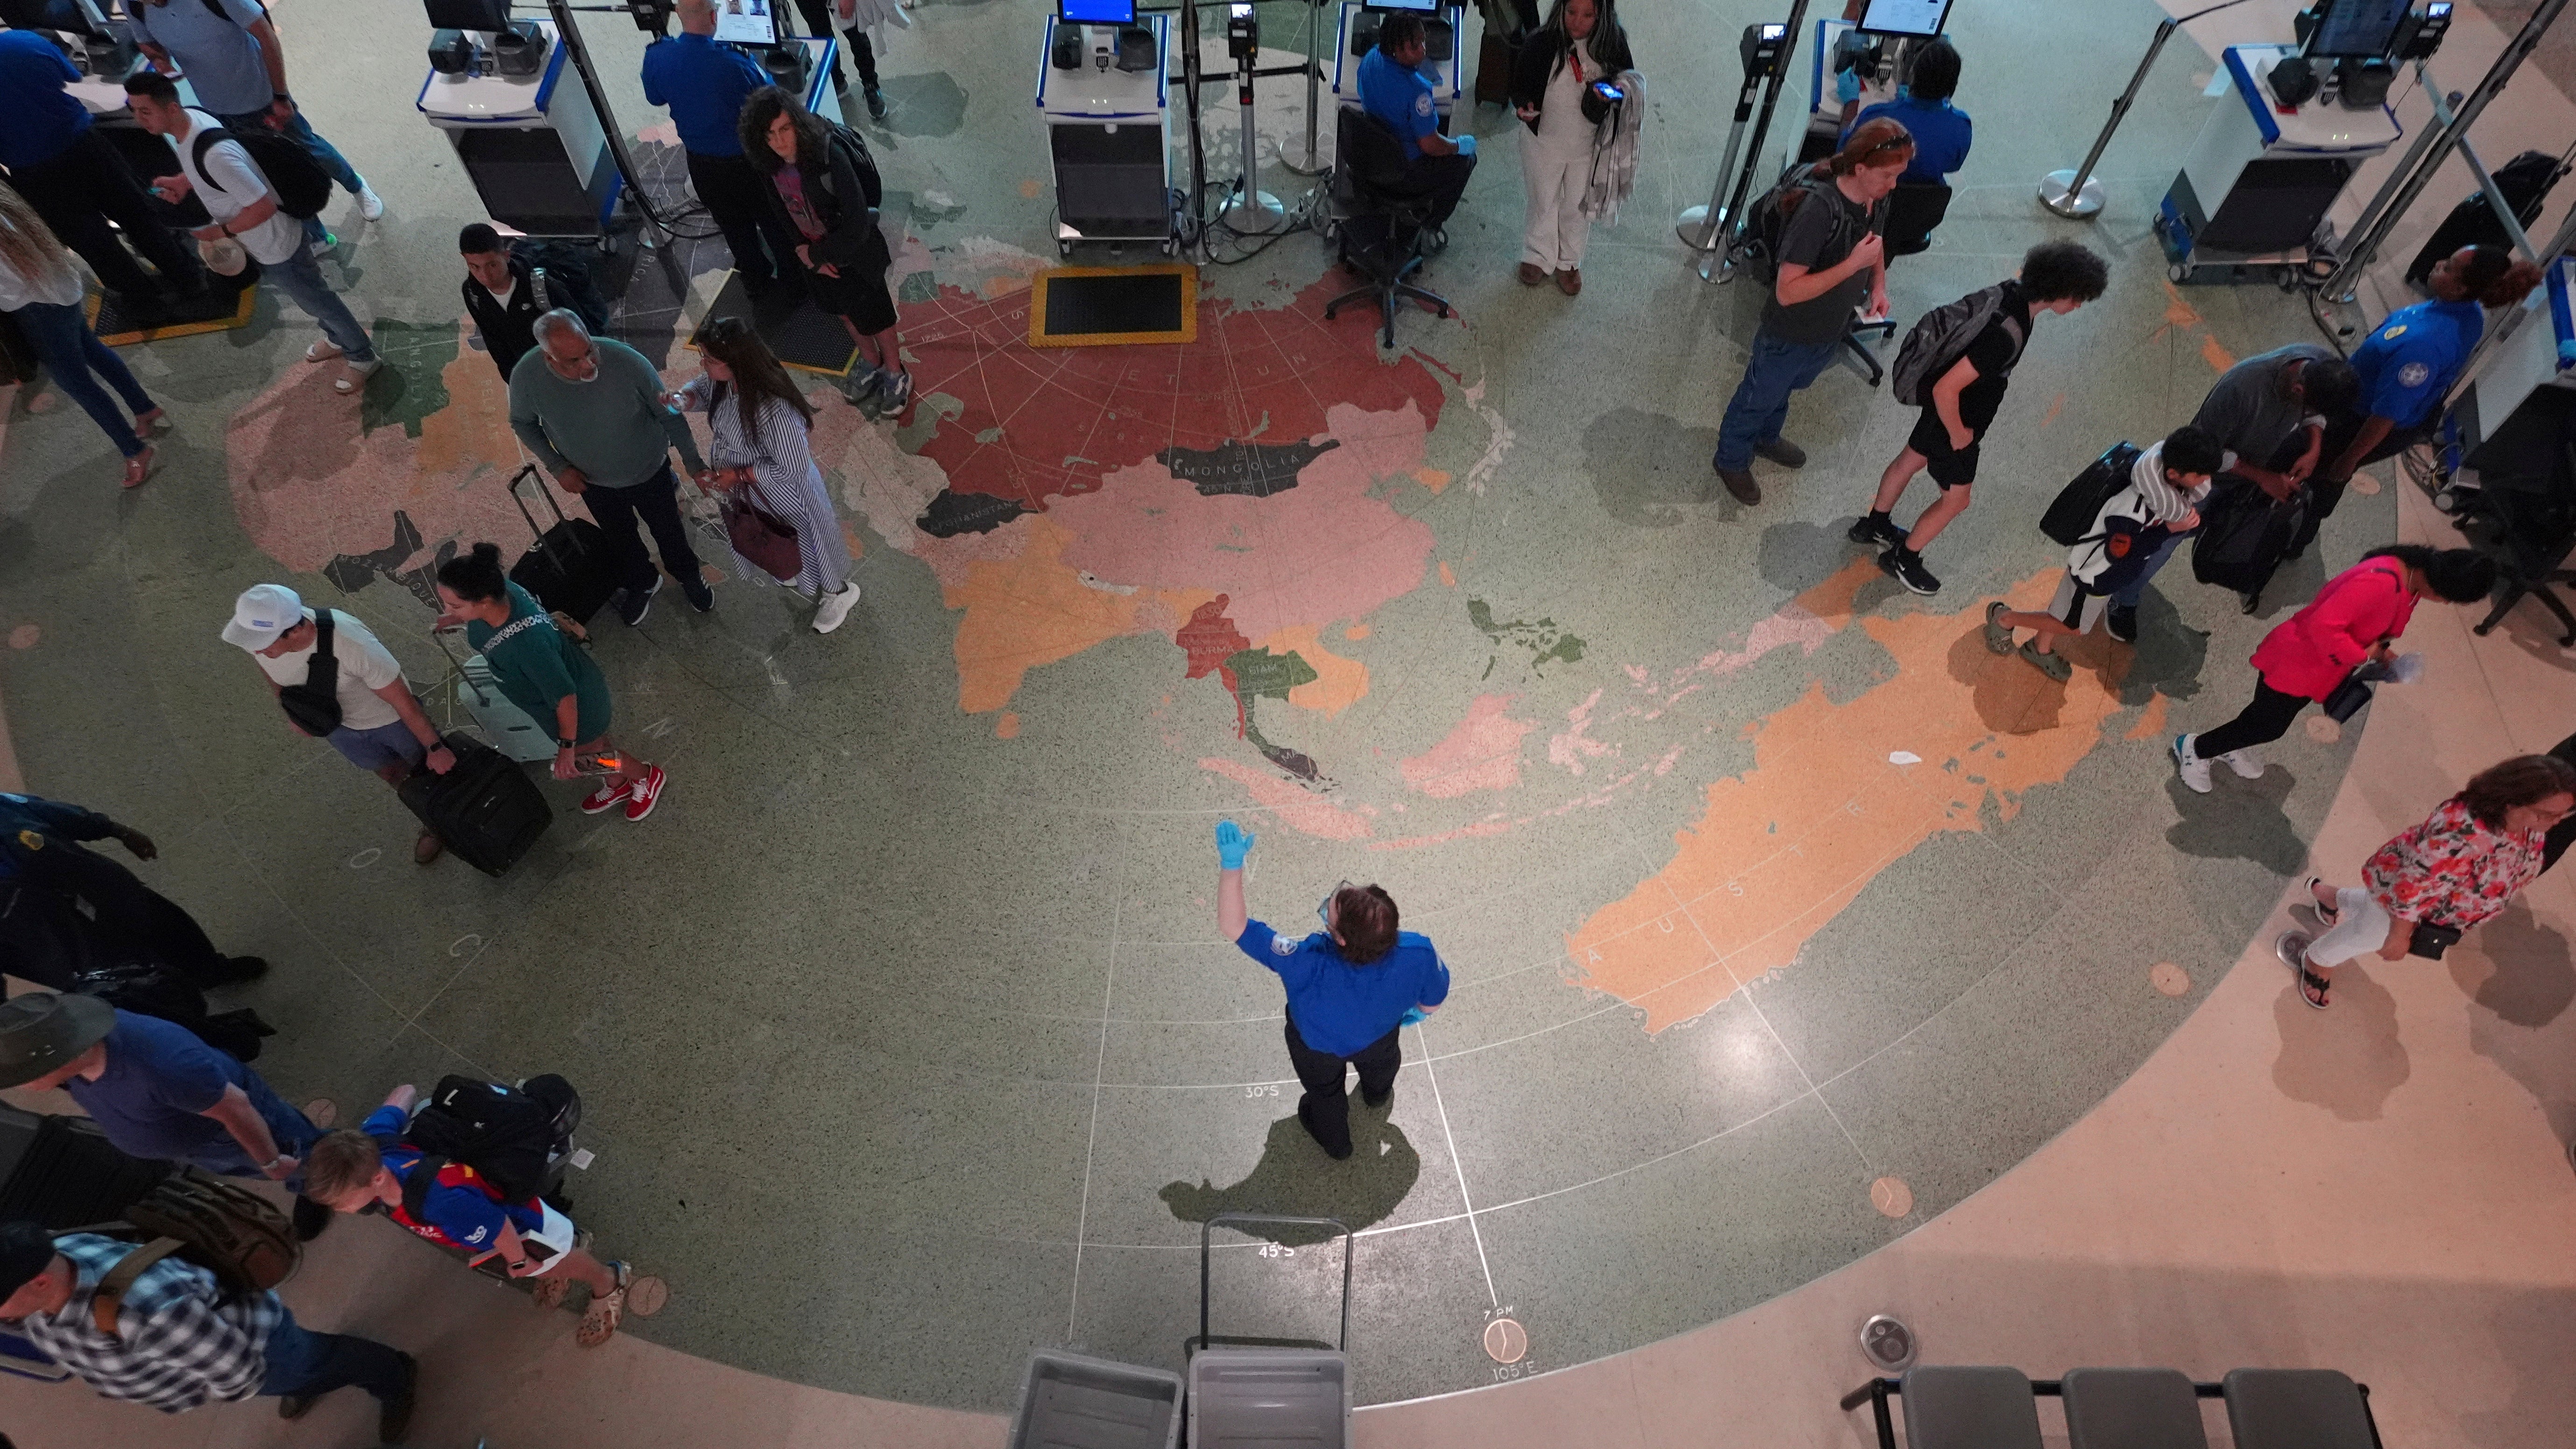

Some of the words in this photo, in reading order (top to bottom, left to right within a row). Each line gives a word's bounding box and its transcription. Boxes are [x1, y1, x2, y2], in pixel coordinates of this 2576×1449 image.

[409, 337, 423, 405] ANGOLA
[1184, 454, 1300, 477] MONGOLIA
[338, 555, 436, 608] MOZAMBIQUE
[1192, 645, 1235, 655] BURMA
[1248, 664, 1278, 675] SIAM
[1245, 1084, 1279, 1098] 30°S
[1259, 1244, 1295, 1258] 45°S
[1496, 1306, 1514, 1318] PM
